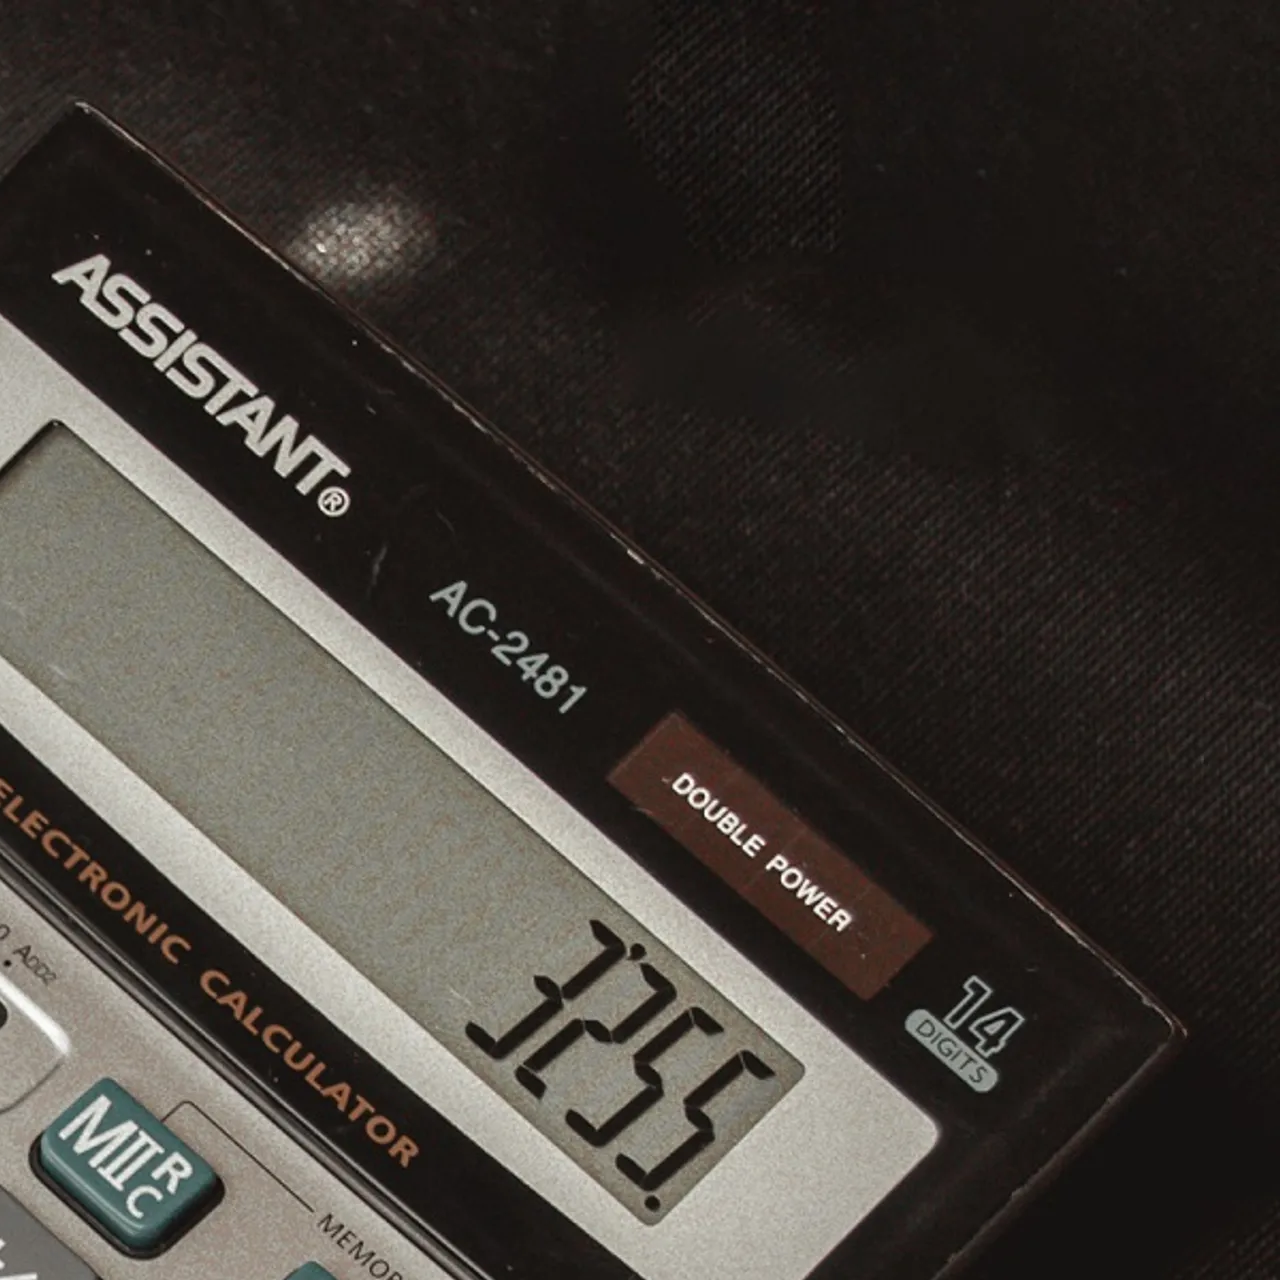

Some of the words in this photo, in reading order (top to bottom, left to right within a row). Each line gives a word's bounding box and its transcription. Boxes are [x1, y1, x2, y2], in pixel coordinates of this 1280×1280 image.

[429, 578, 588, 716] AC-2481
[671, 771, 767, 859] DOUBLE
[764, 854, 854, 934] POWER
[197, 967, 422, 1169] CALCULATOR
[914, 1014, 989, 1087] DIGITS
[940, 974, 1027, 1061] 14
